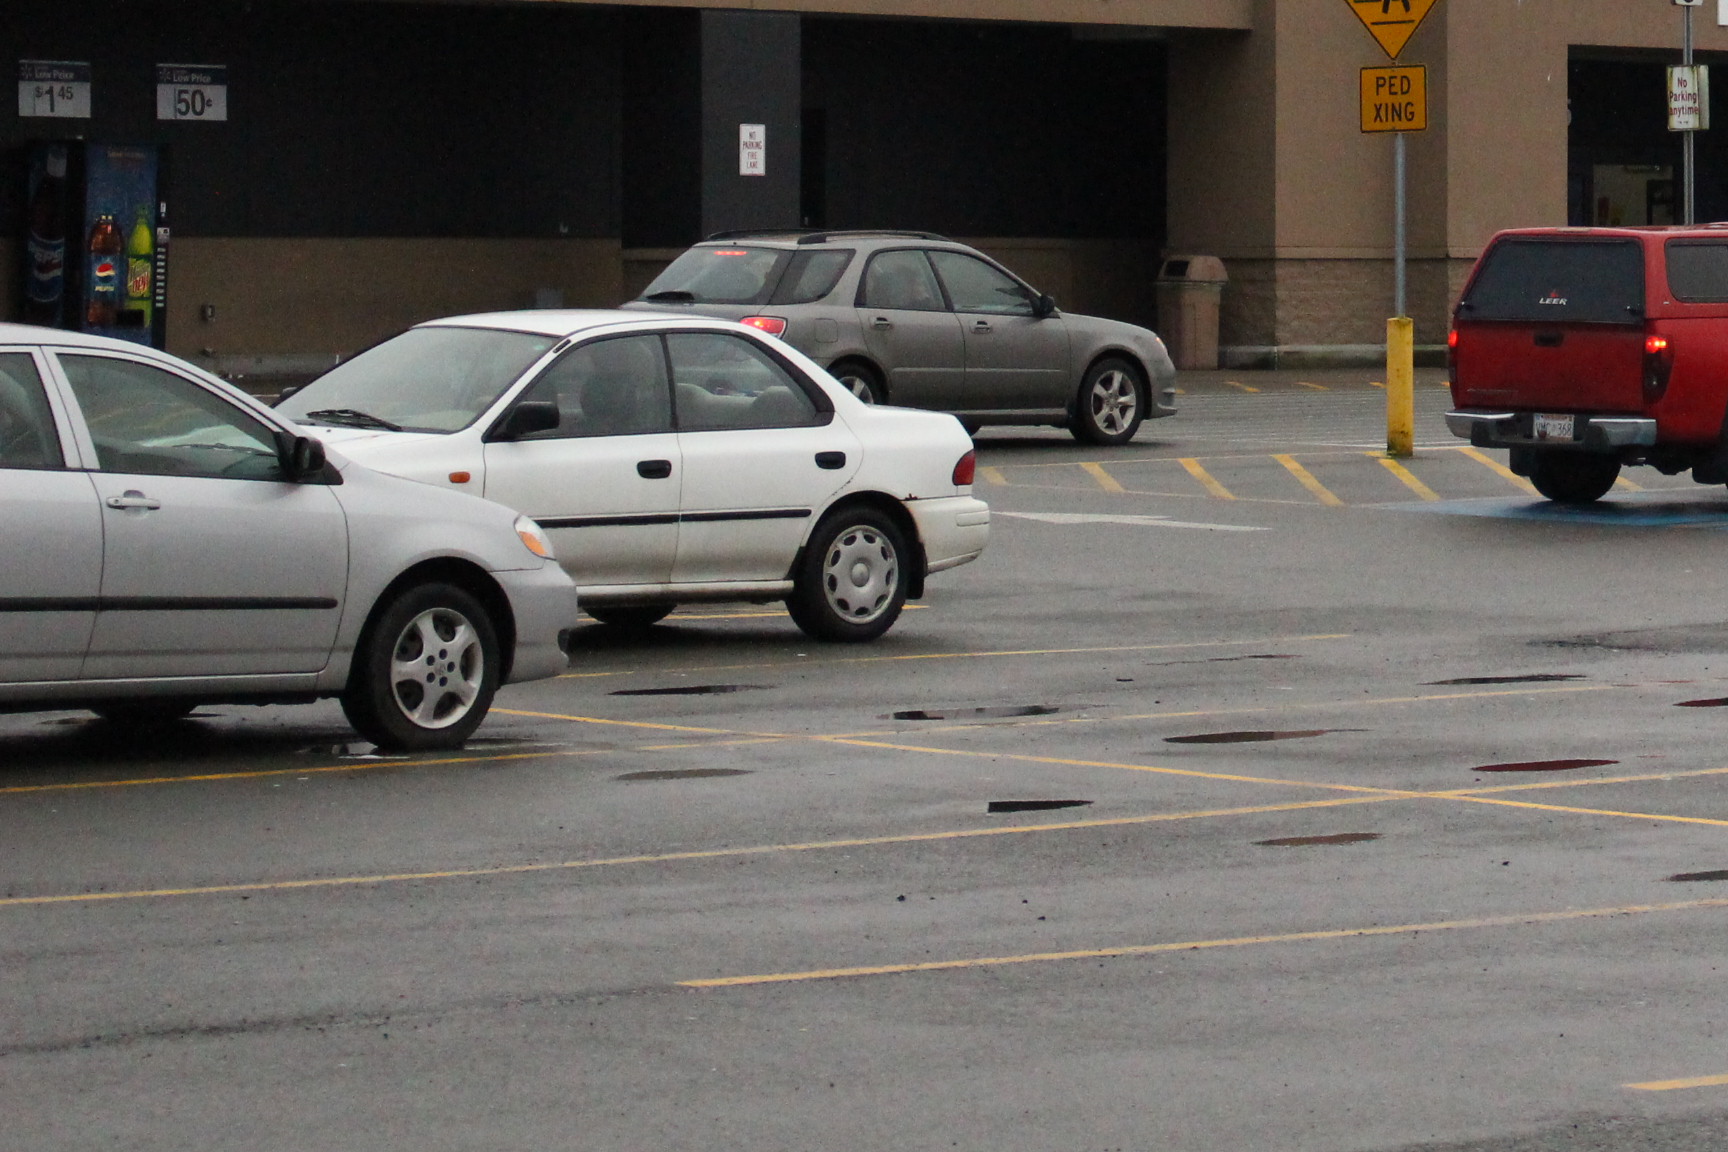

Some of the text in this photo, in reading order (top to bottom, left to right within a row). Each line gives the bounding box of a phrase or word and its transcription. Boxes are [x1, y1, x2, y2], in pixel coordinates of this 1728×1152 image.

[172, 74, 212, 83] Low Price
[1677, 77, 1688, 88] No
[1375, 75, 1411, 96] PED
[1669, 91, 1697, 104] Parking
[1373, 101, 1415, 123] XING
[1669, 105, 1700, 118] anytime
[743, 140, 763, 150] PARKING
[1539, 297, 1568, 306] LEER
